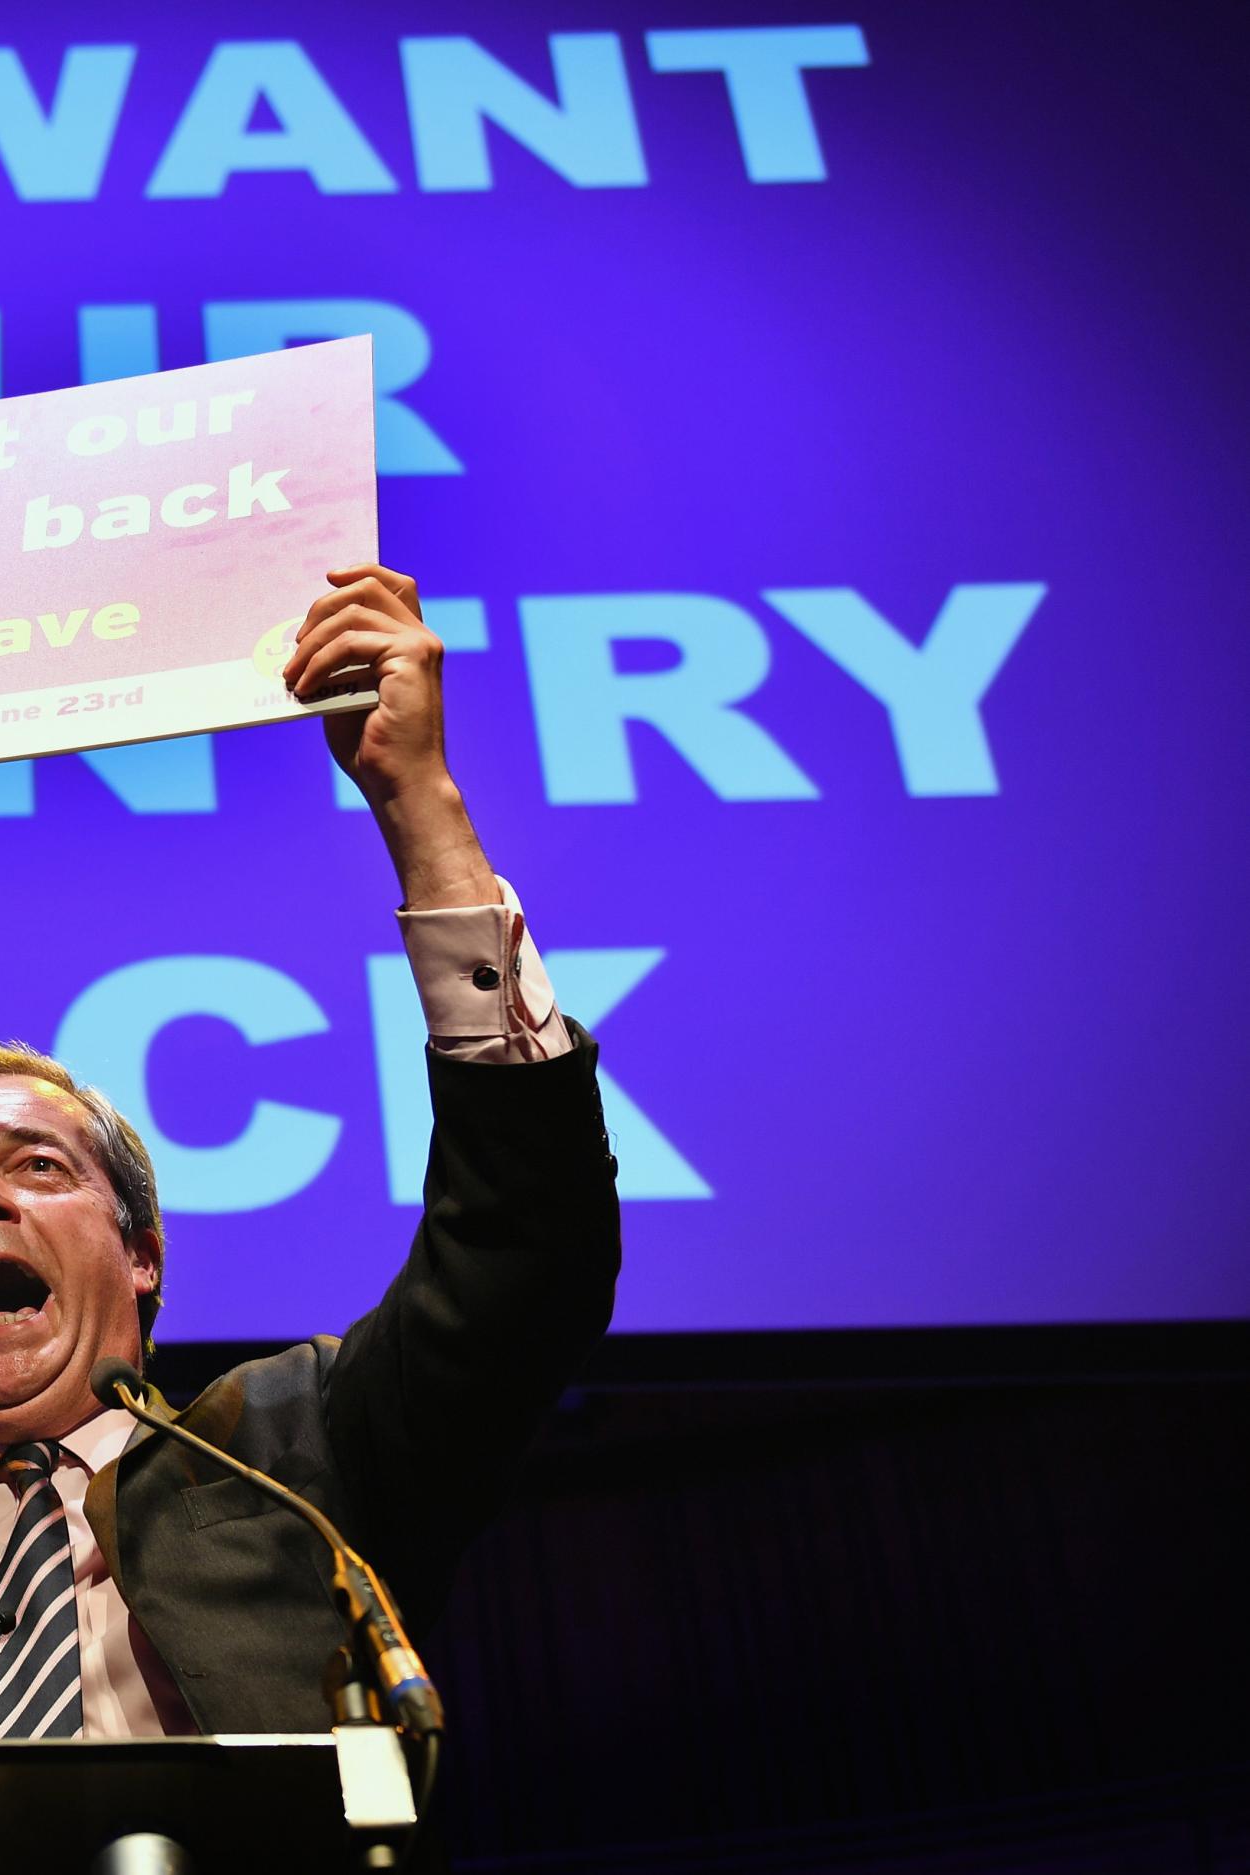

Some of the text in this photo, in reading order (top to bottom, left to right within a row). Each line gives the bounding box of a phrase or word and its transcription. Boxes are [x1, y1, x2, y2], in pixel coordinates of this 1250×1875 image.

[66, 389, 257, 456] our
[21, 460, 293, 552] back
[55, 685, 145, 717] 23rd
